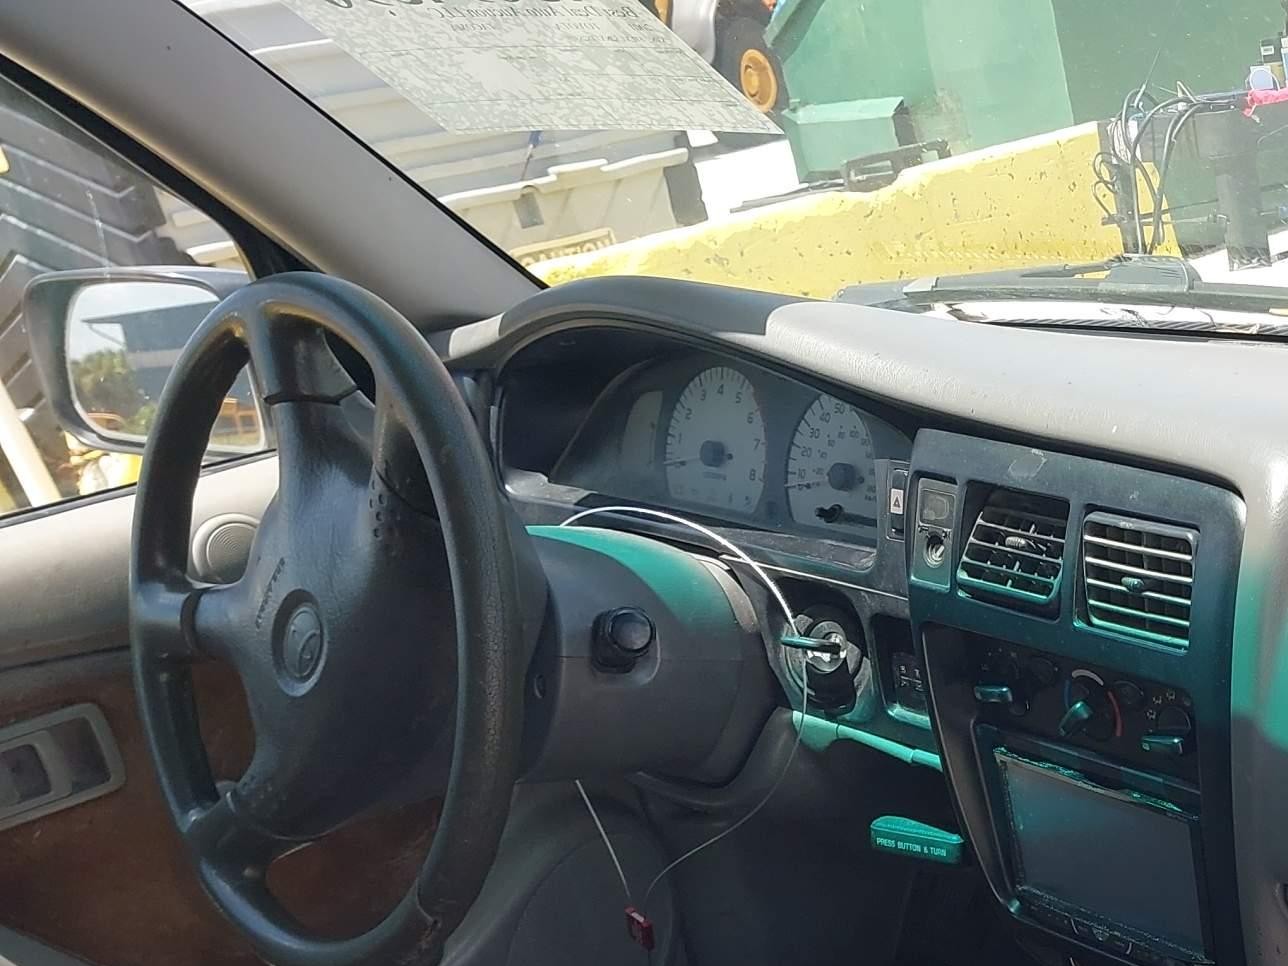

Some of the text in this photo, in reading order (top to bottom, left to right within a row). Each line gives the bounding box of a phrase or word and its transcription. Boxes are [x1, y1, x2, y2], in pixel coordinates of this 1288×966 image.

[716, 383, 725, 396] 4
[833, 402, 846, 415] 50
[808, 427, 821, 439] 30
[753, 438, 762, 450] 7
[800, 446, 812, 458] 20
[876, 837, 896, 848] PRESS
[897, 841, 921, 853] BUTTON
[930, 846, 947, 857] TURN
